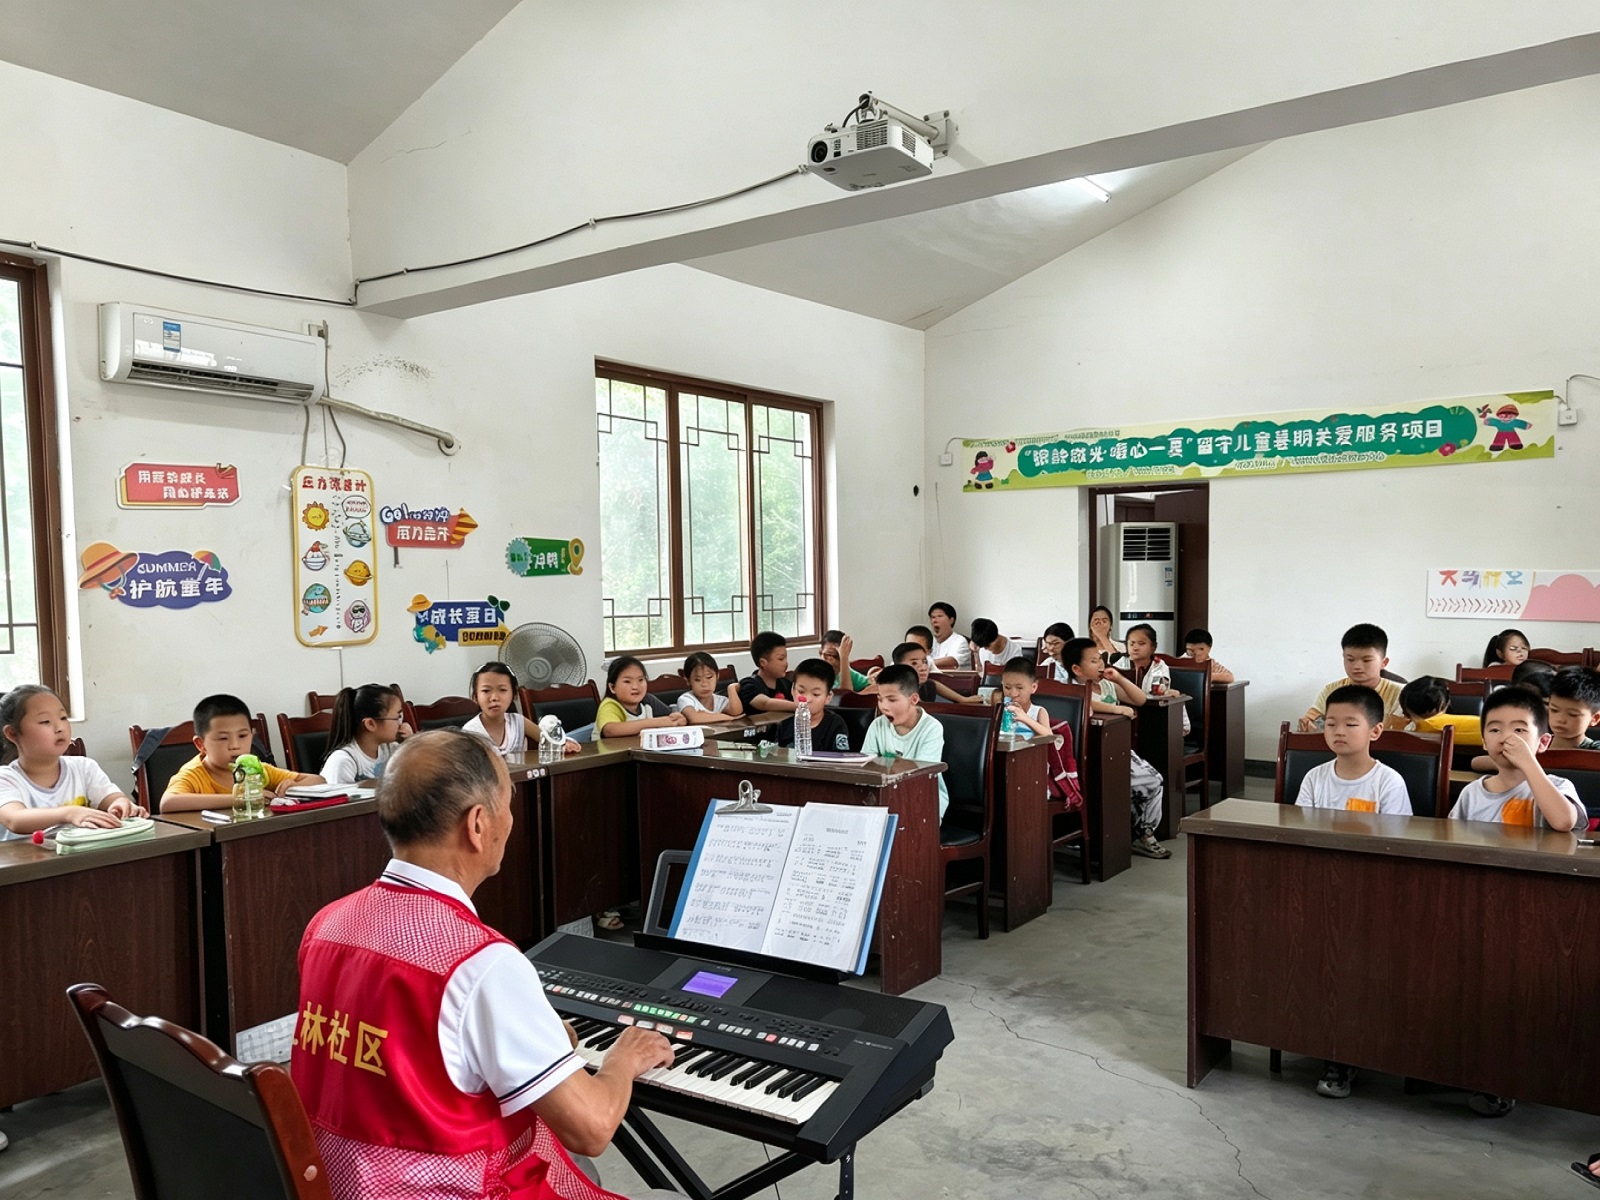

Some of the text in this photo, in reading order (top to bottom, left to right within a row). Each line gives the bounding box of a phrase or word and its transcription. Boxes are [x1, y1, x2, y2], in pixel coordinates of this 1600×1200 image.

[129, 576, 225, 600] 护航童年
[293, 1000, 389, 1077] 林社区
